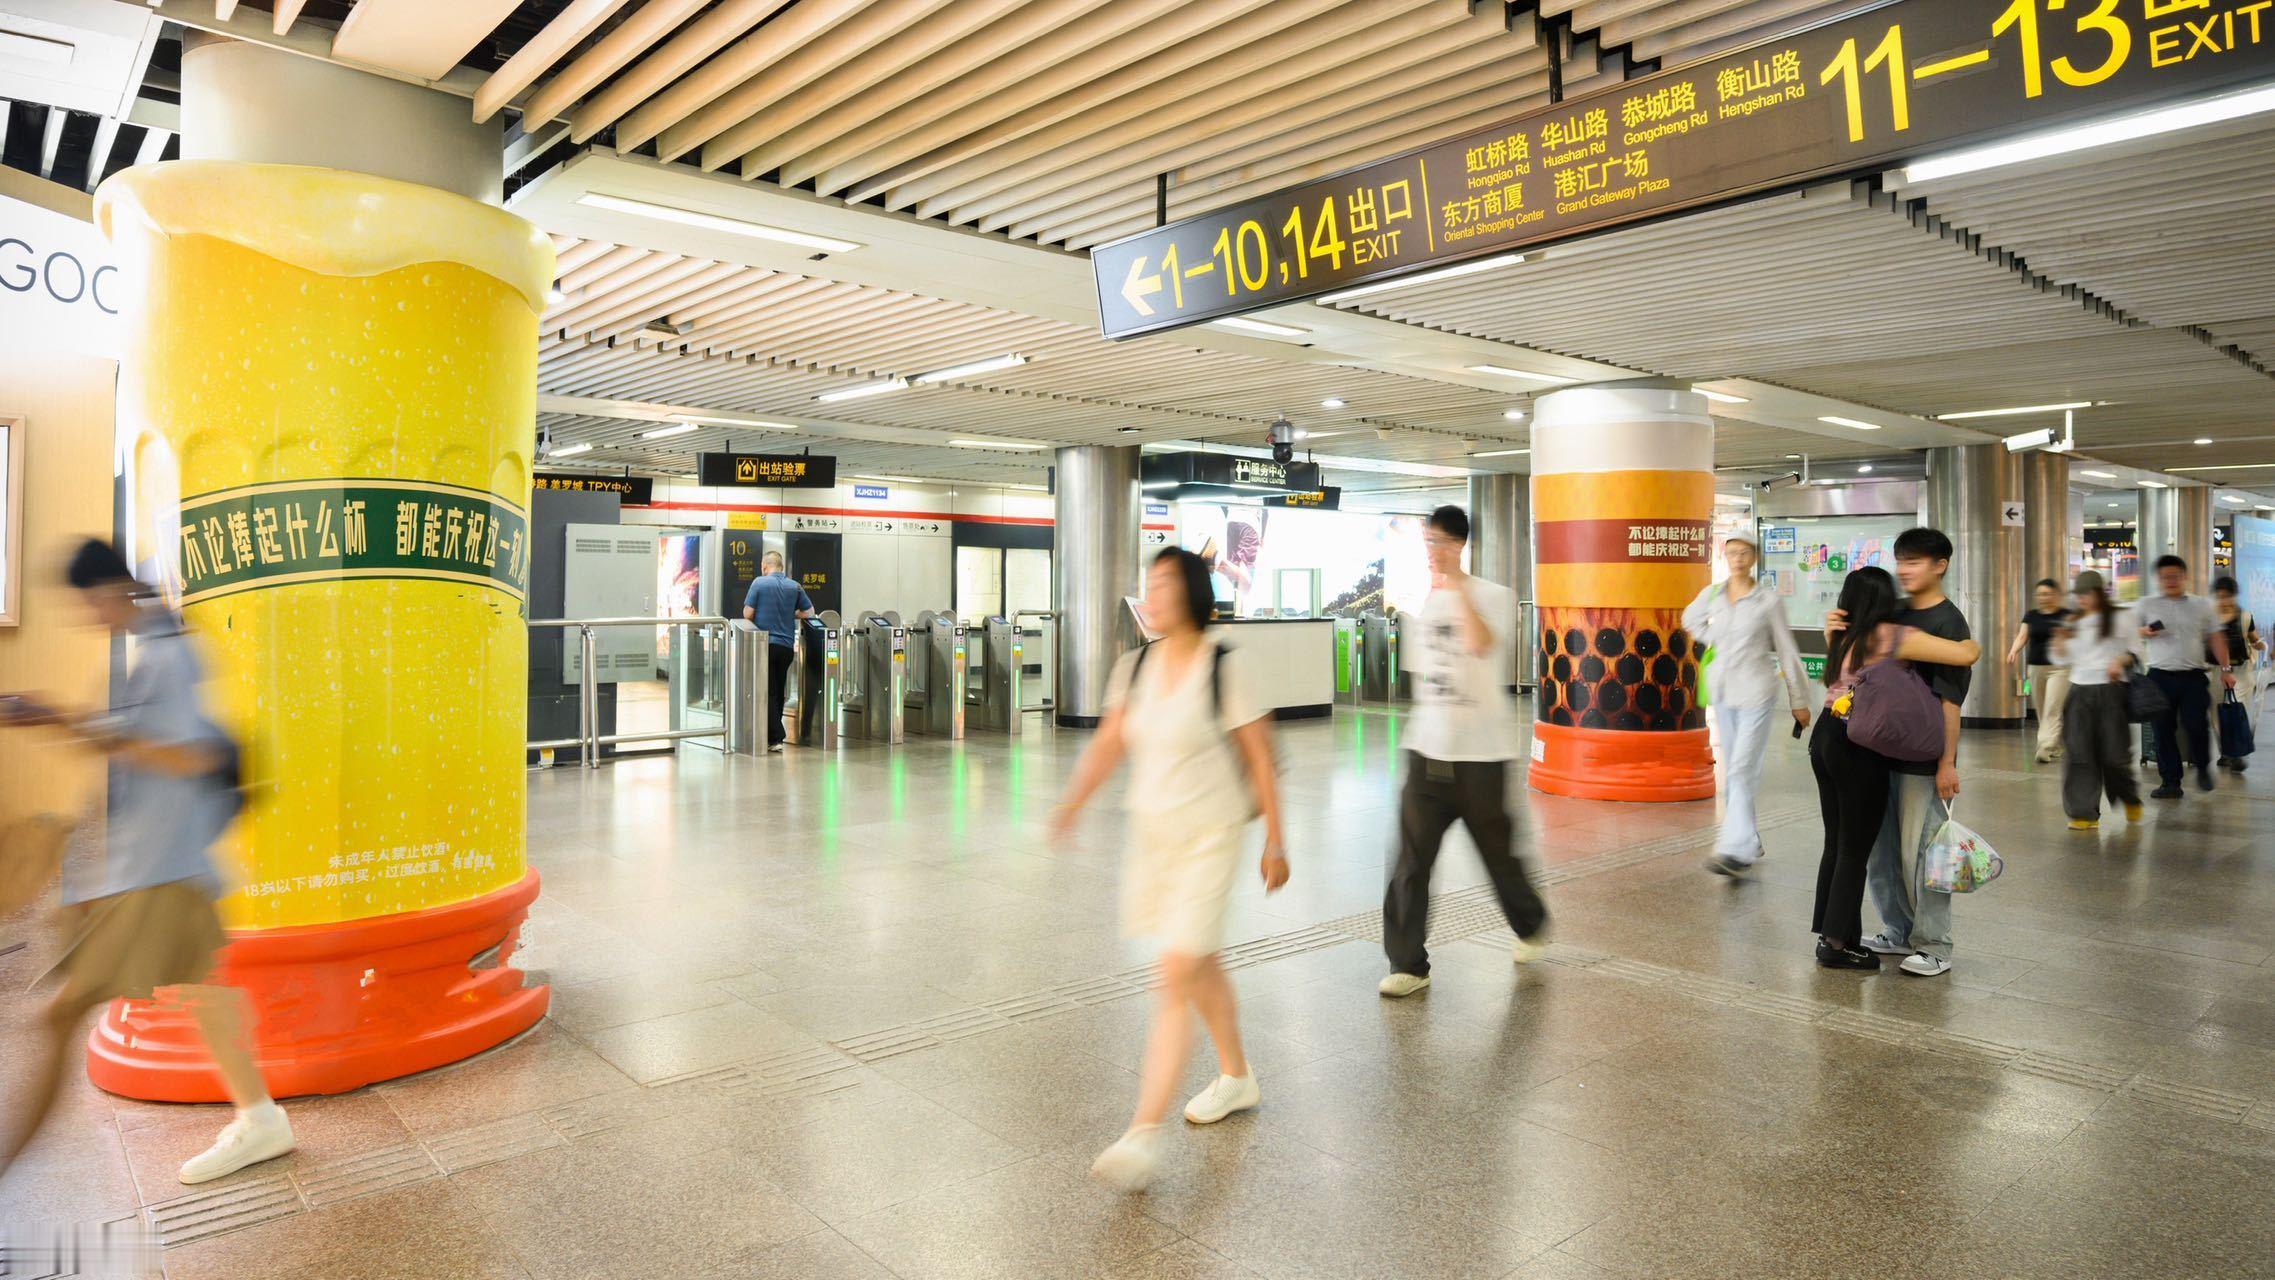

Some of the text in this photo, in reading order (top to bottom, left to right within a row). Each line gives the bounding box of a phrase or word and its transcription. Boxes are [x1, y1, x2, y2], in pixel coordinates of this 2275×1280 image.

[2150, 1, 2273, 68] EXIT
[1466, 49, 1801, 173] 虹桥路 华山路 恭城路 衡山路
[1467, 83, 1805, 190] Hongqiao Rd Huashan Rd Gongcheng Rd Hengshan Rd
[1348, 179, 1412, 234] 出口
[1441, 150, 1649, 228] 东方商厦 港汇广场
[1444, 177, 1670, 242] Oriental Shopping Center Grand Gateway Plaza
[1353, 230, 1401, 265] EXIT
[760, 462, 806, 476] 出站验票
[1251, 462, 1286, 478] 服务中心
[730, 540, 746, 556] 10
[1832, 559, 1840, 569] 3
